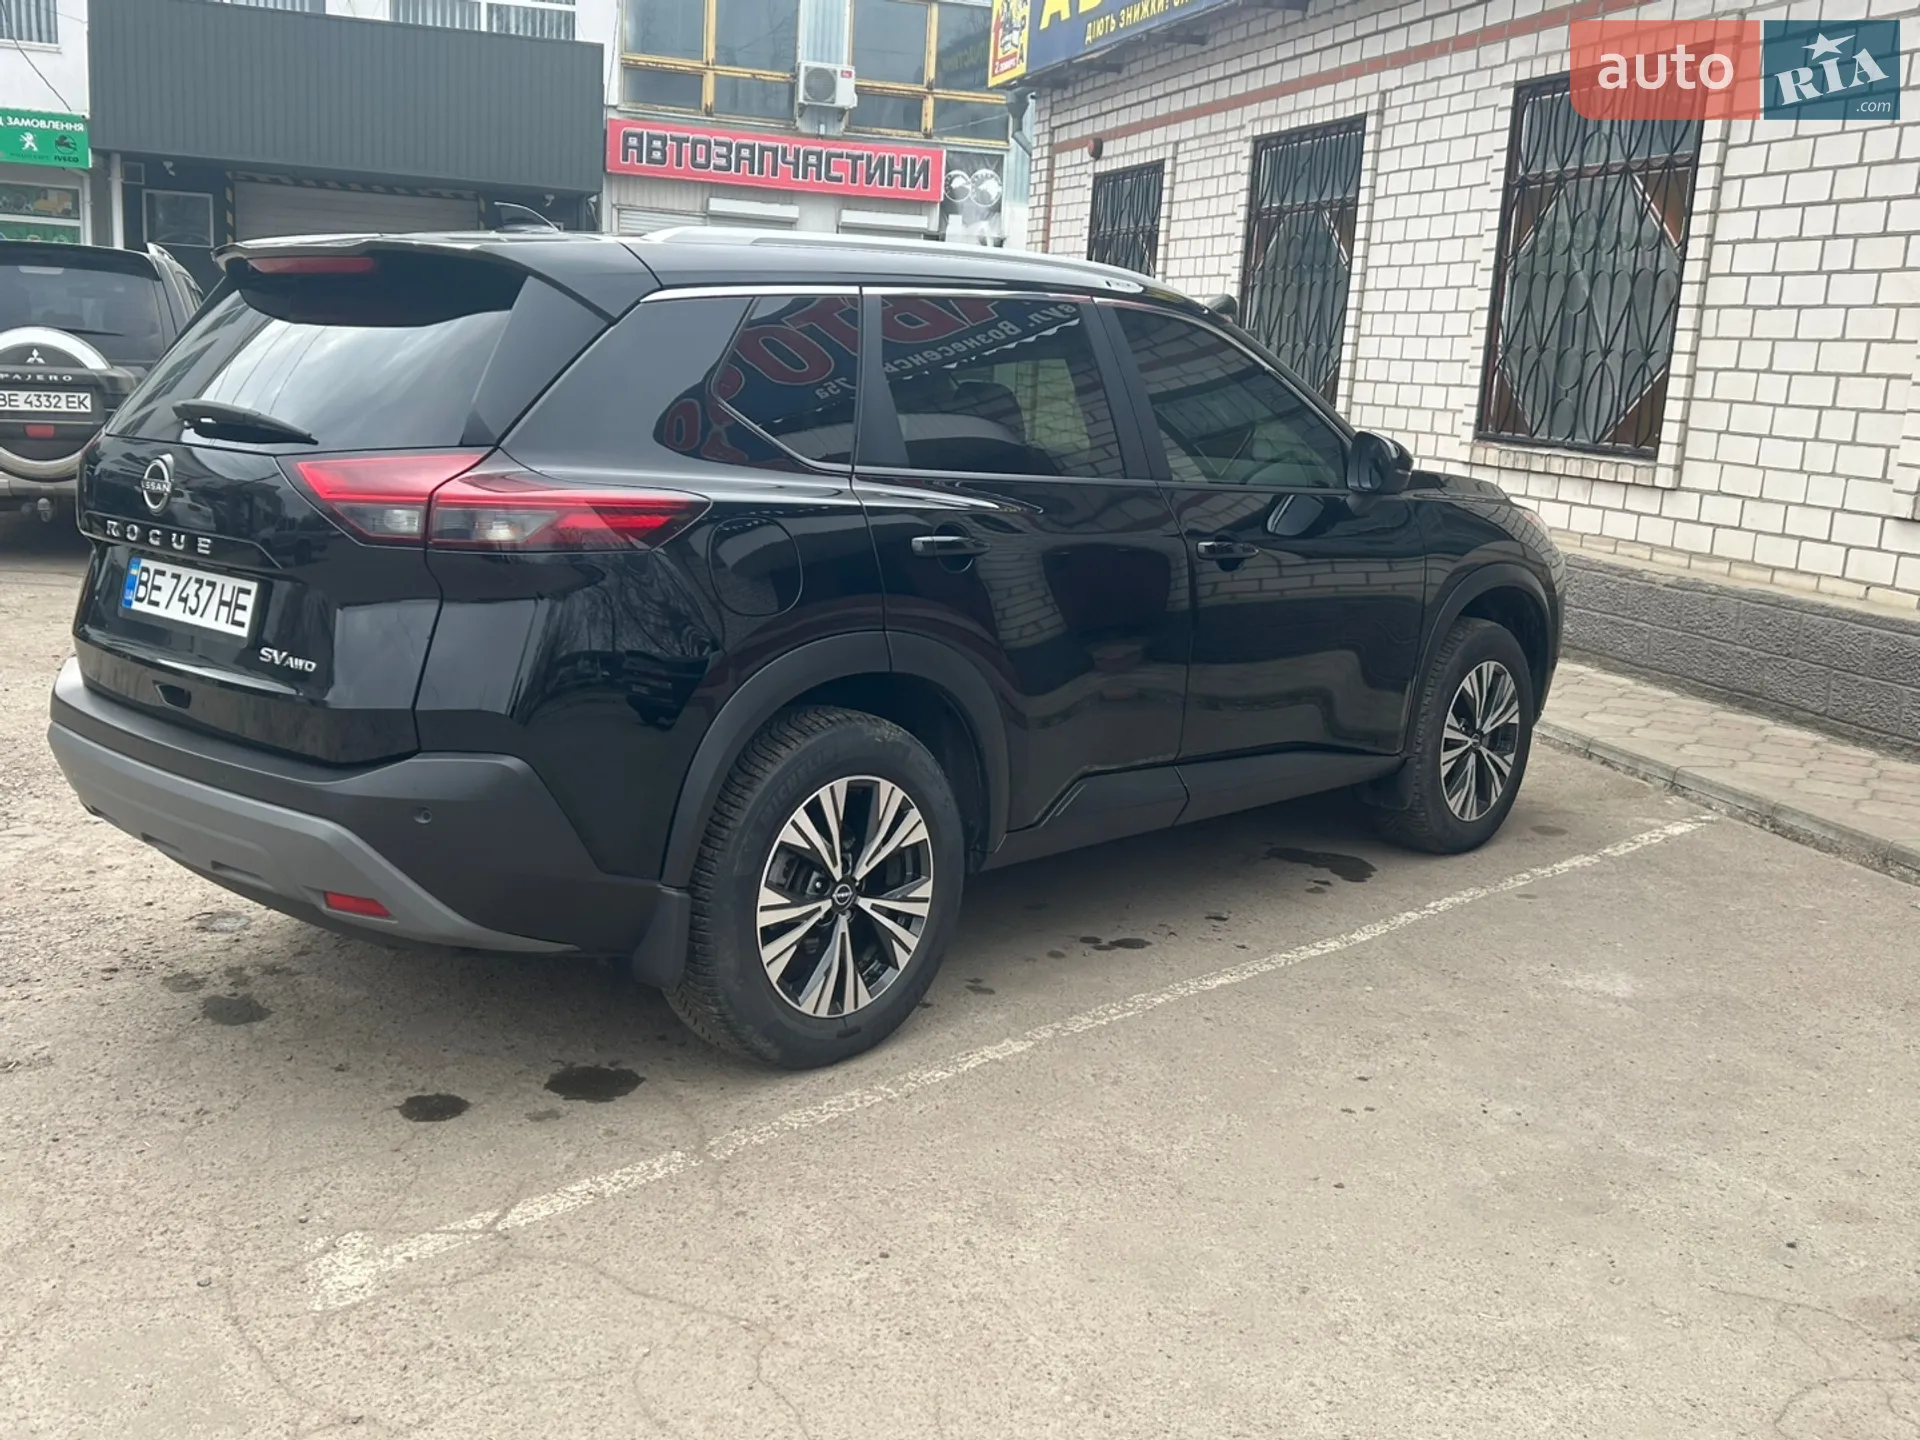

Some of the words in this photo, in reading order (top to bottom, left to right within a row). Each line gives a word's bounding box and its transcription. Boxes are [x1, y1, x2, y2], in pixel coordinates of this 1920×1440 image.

[1085, 13, 1117, 45] ДІЮТЬ
[6, 116, 85, 132] ЗАМОВЛЕННЯ
[54, 155, 79, 163] IVECO
[620, 127, 931, 192] АВТОЗАПЧАСТИНИ
[0, 373, 73, 382] PAJERO
[24, 394, 62, 409] 4332
[66, 395, 90, 410] EK
[106, 519, 213, 555] ROGUE
